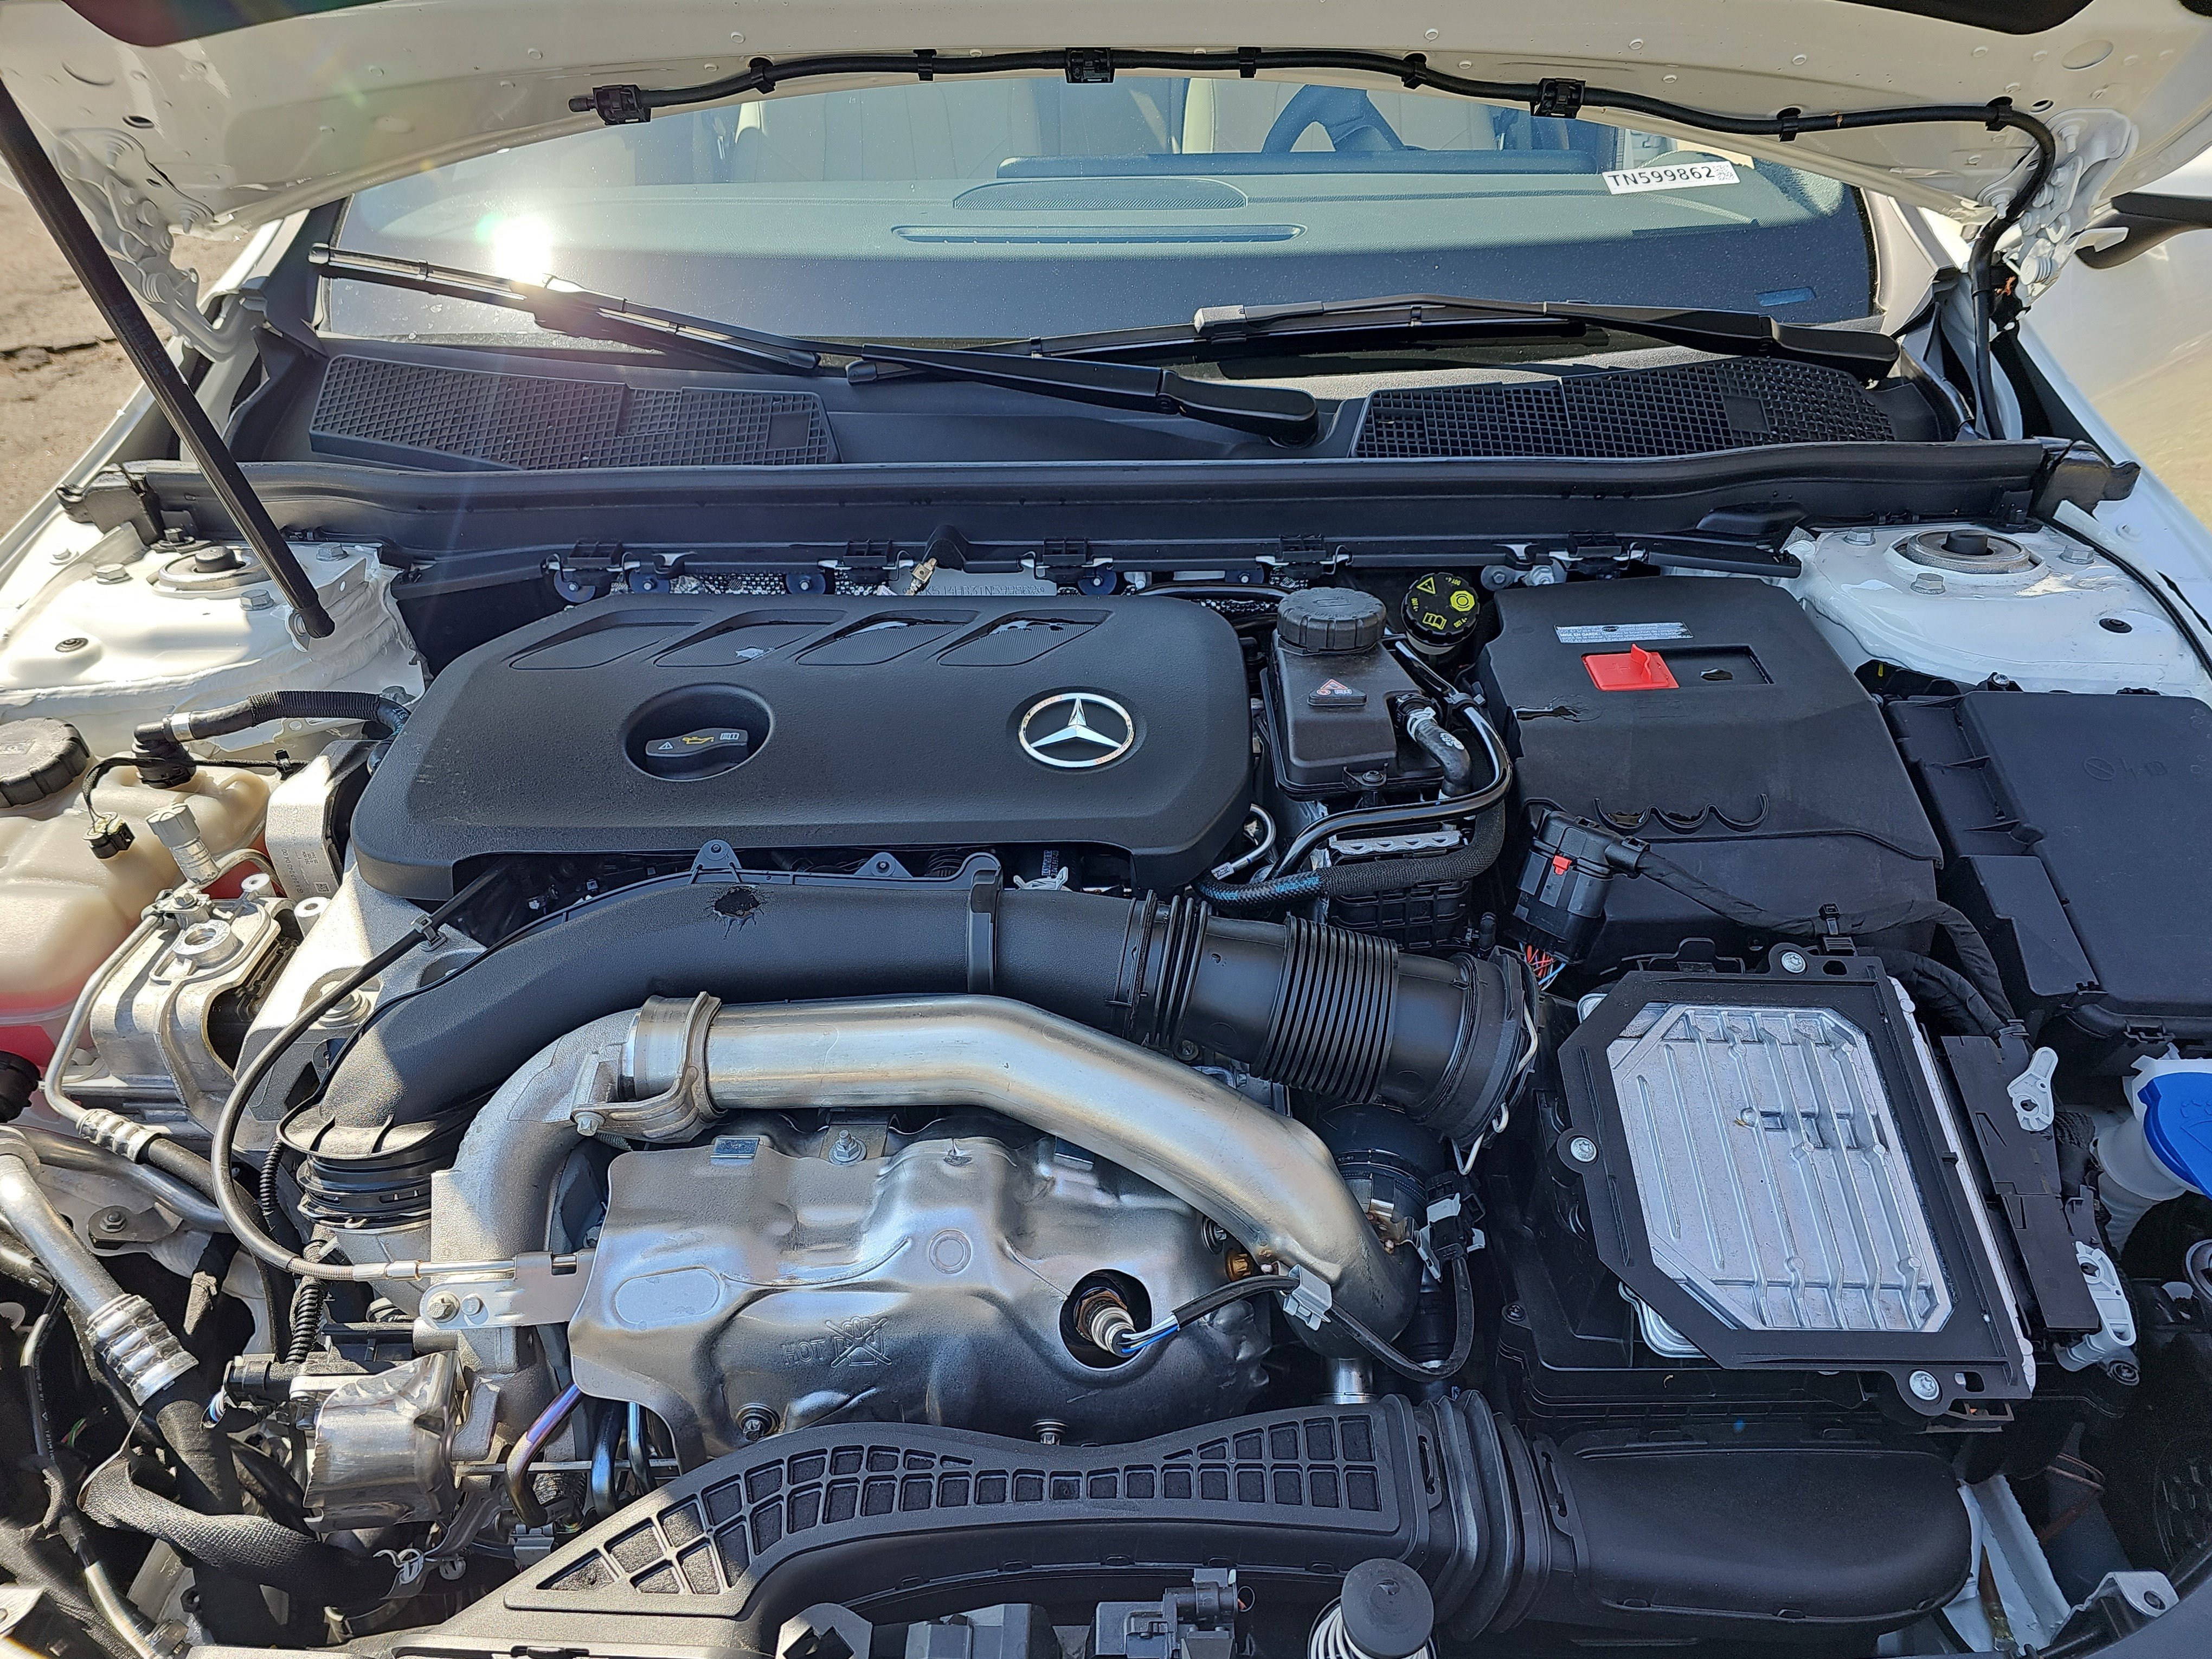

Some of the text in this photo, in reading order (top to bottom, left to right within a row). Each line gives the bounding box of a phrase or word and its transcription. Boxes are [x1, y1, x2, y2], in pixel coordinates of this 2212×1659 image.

[1607, 166, 1715, 186] TN599862
[287, 864, 295, 873] 240
[781, 1338, 825, 1365] HOT
